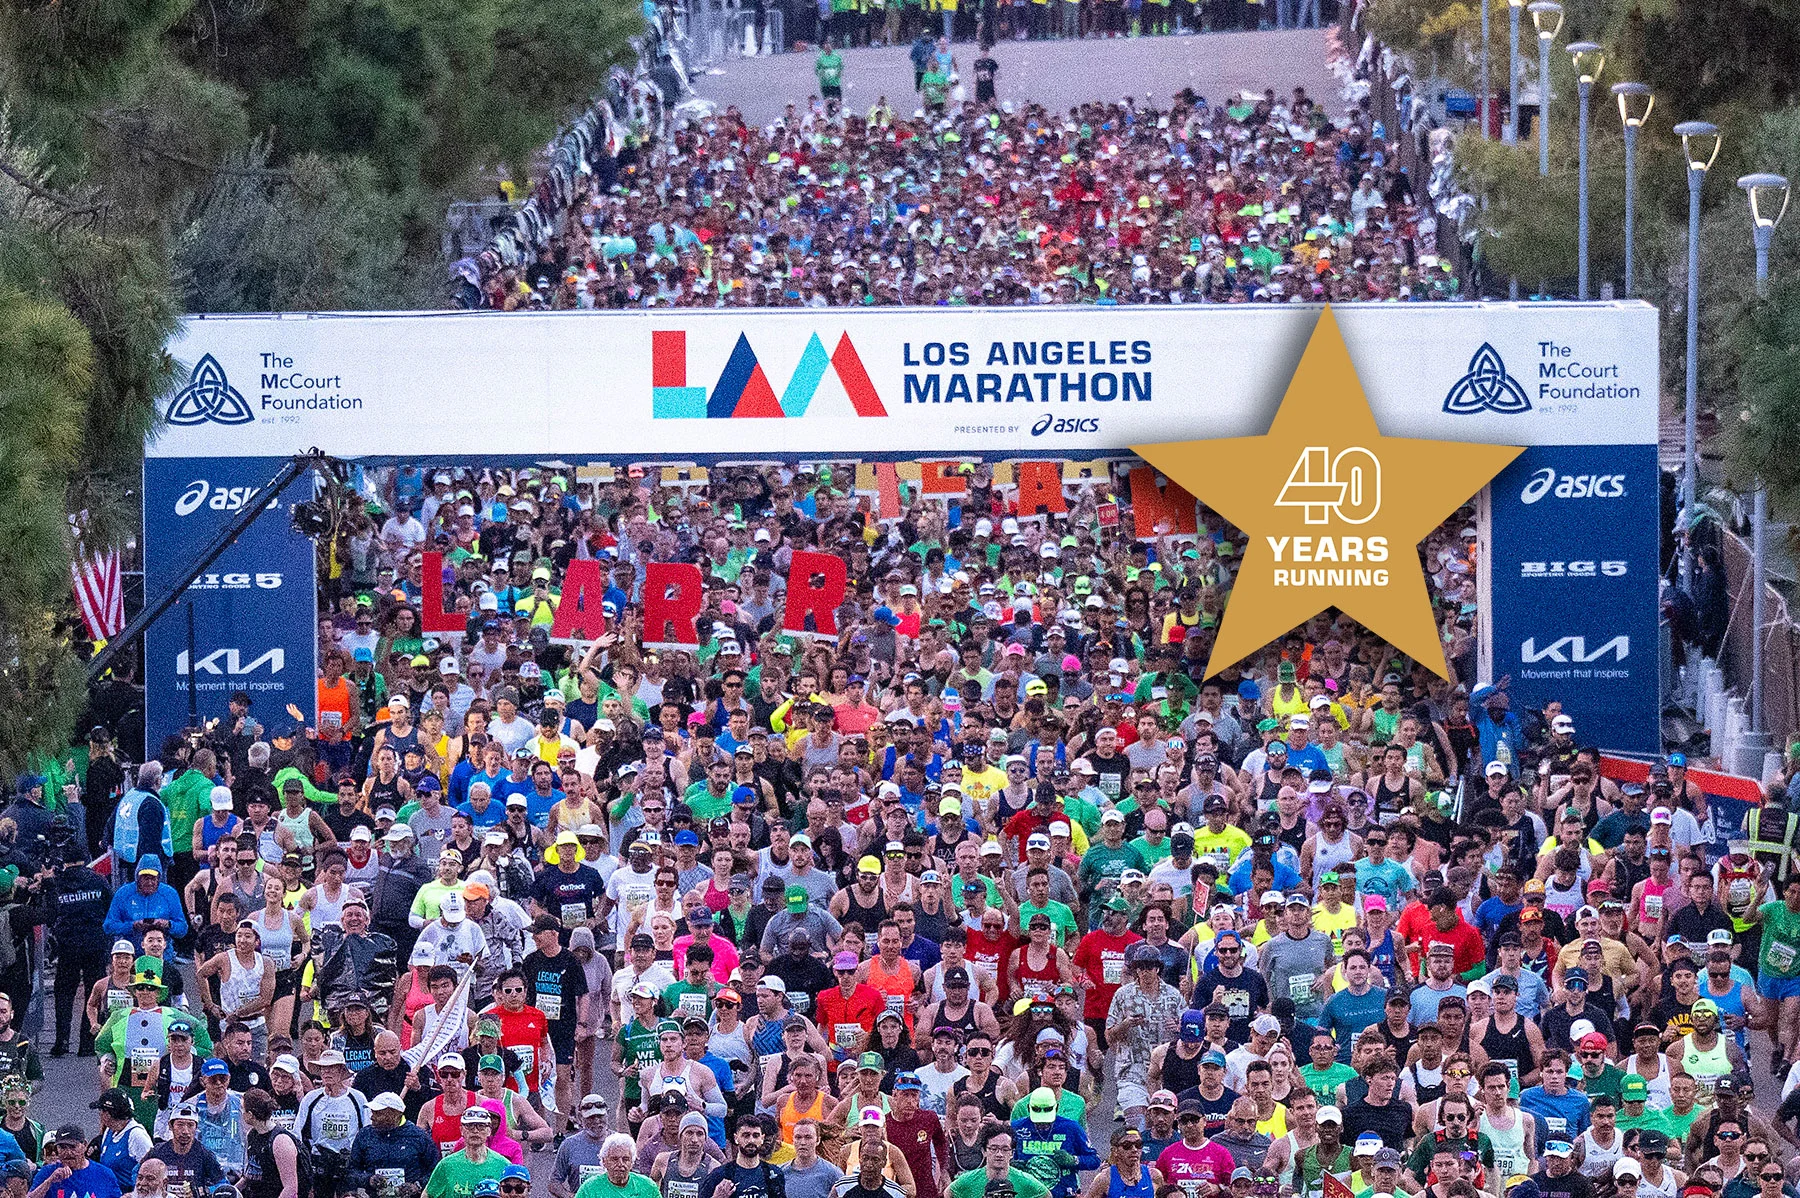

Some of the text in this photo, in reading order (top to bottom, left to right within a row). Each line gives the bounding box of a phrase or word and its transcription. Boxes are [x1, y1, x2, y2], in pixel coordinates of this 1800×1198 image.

[903, 340, 1152, 366] LOS ANGELES
[1538, 341, 1571, 357] The
[260, 352, 293, 368] The
[1538, 362, 1619, 378] McCourt
[261, 373, 341, 389] McCourt
[903, 372, 1152, 403] MARATHON
[1539, 383, 1640, 399] Foundation
[261, 393, 362, 410] Foundation
[953, 425, 1006, 434] PRESENTED
[1008, 425, 1019, 433] BY
[1521, 561, 1628, 577] BIG 5
[192, 573, 283, 589] IG 5
[1521, 635, 1630, 663] KIA
[176, 648, 285, 675] KIA
[1521, 669, 1629, 679] Movement that inspires
[176, 681, 285, 692] Moement that inspires
[58, 889, 102, 904] SECURITY
[345, 1050, 371, 1061] LEGACY
[636, 1050, 655, 1060] WE
[639, 1059, 662, 1070] RUN
[1205, 1112, 1228, 1121] nTrac
